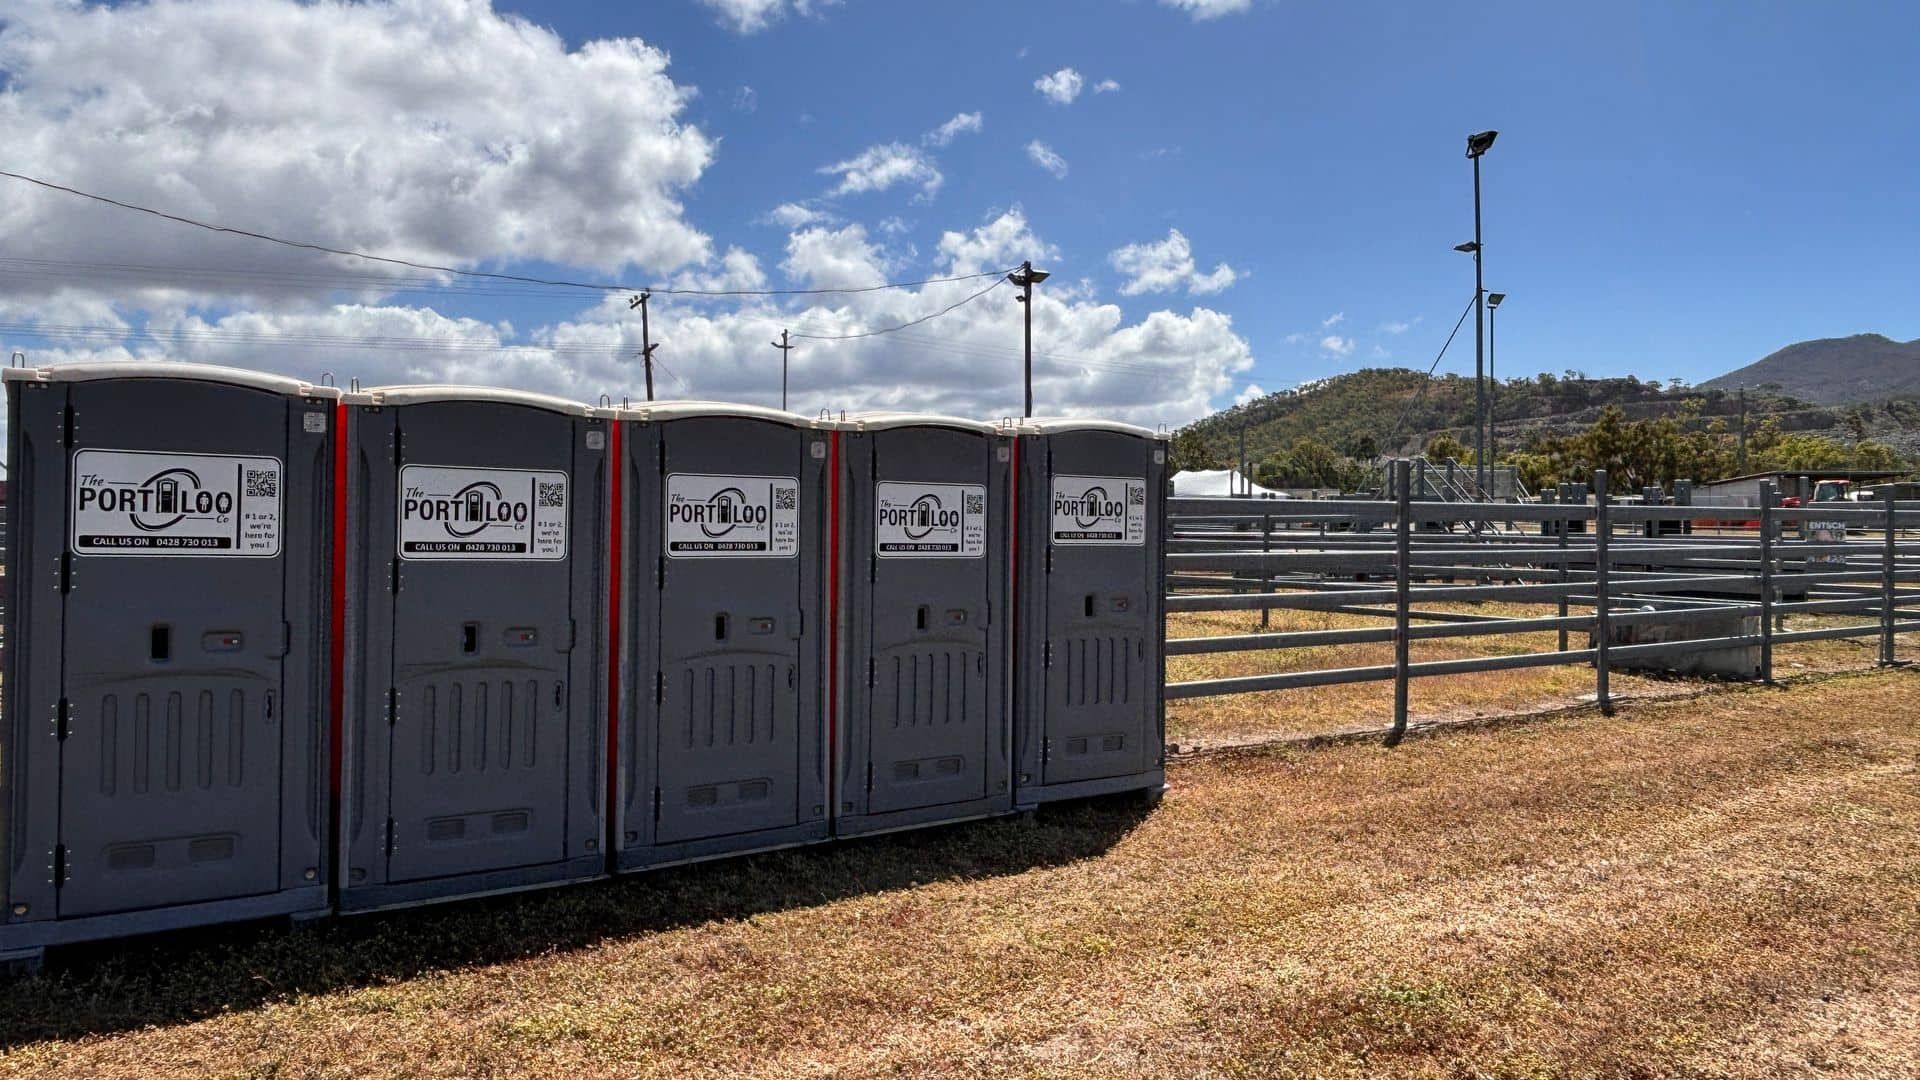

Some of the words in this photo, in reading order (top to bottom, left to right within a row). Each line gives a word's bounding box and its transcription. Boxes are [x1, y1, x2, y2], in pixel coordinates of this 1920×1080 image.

[80, 475, 104, 486] The
[406, 487, 424, 498] The
[671, 493, 685, 502] The
[79, 488, 154, 512] PORT
[181, 490, 232, 514] LOO
[404, 499, 464, 521] PORT
[486, 501, 527, 522] LOO
[670, 504, 716, 523] PORT
[734, 505, 766, 523] LOO
[1055, 500, 1086, 516] PORT
[1099, 501, 1123, 517] LOO
[216, 515, 229, 524] Co
[880, 509, 917, 527] PORT
[931, 510, 959, 527] LOO
[93, 537, 116, 545] CALL
[118, 537, 132, 545] US
[134, 538, 149, 546] ON
[156, 538, 180, 546] 0428
[182, 538, 199, 546] 730
